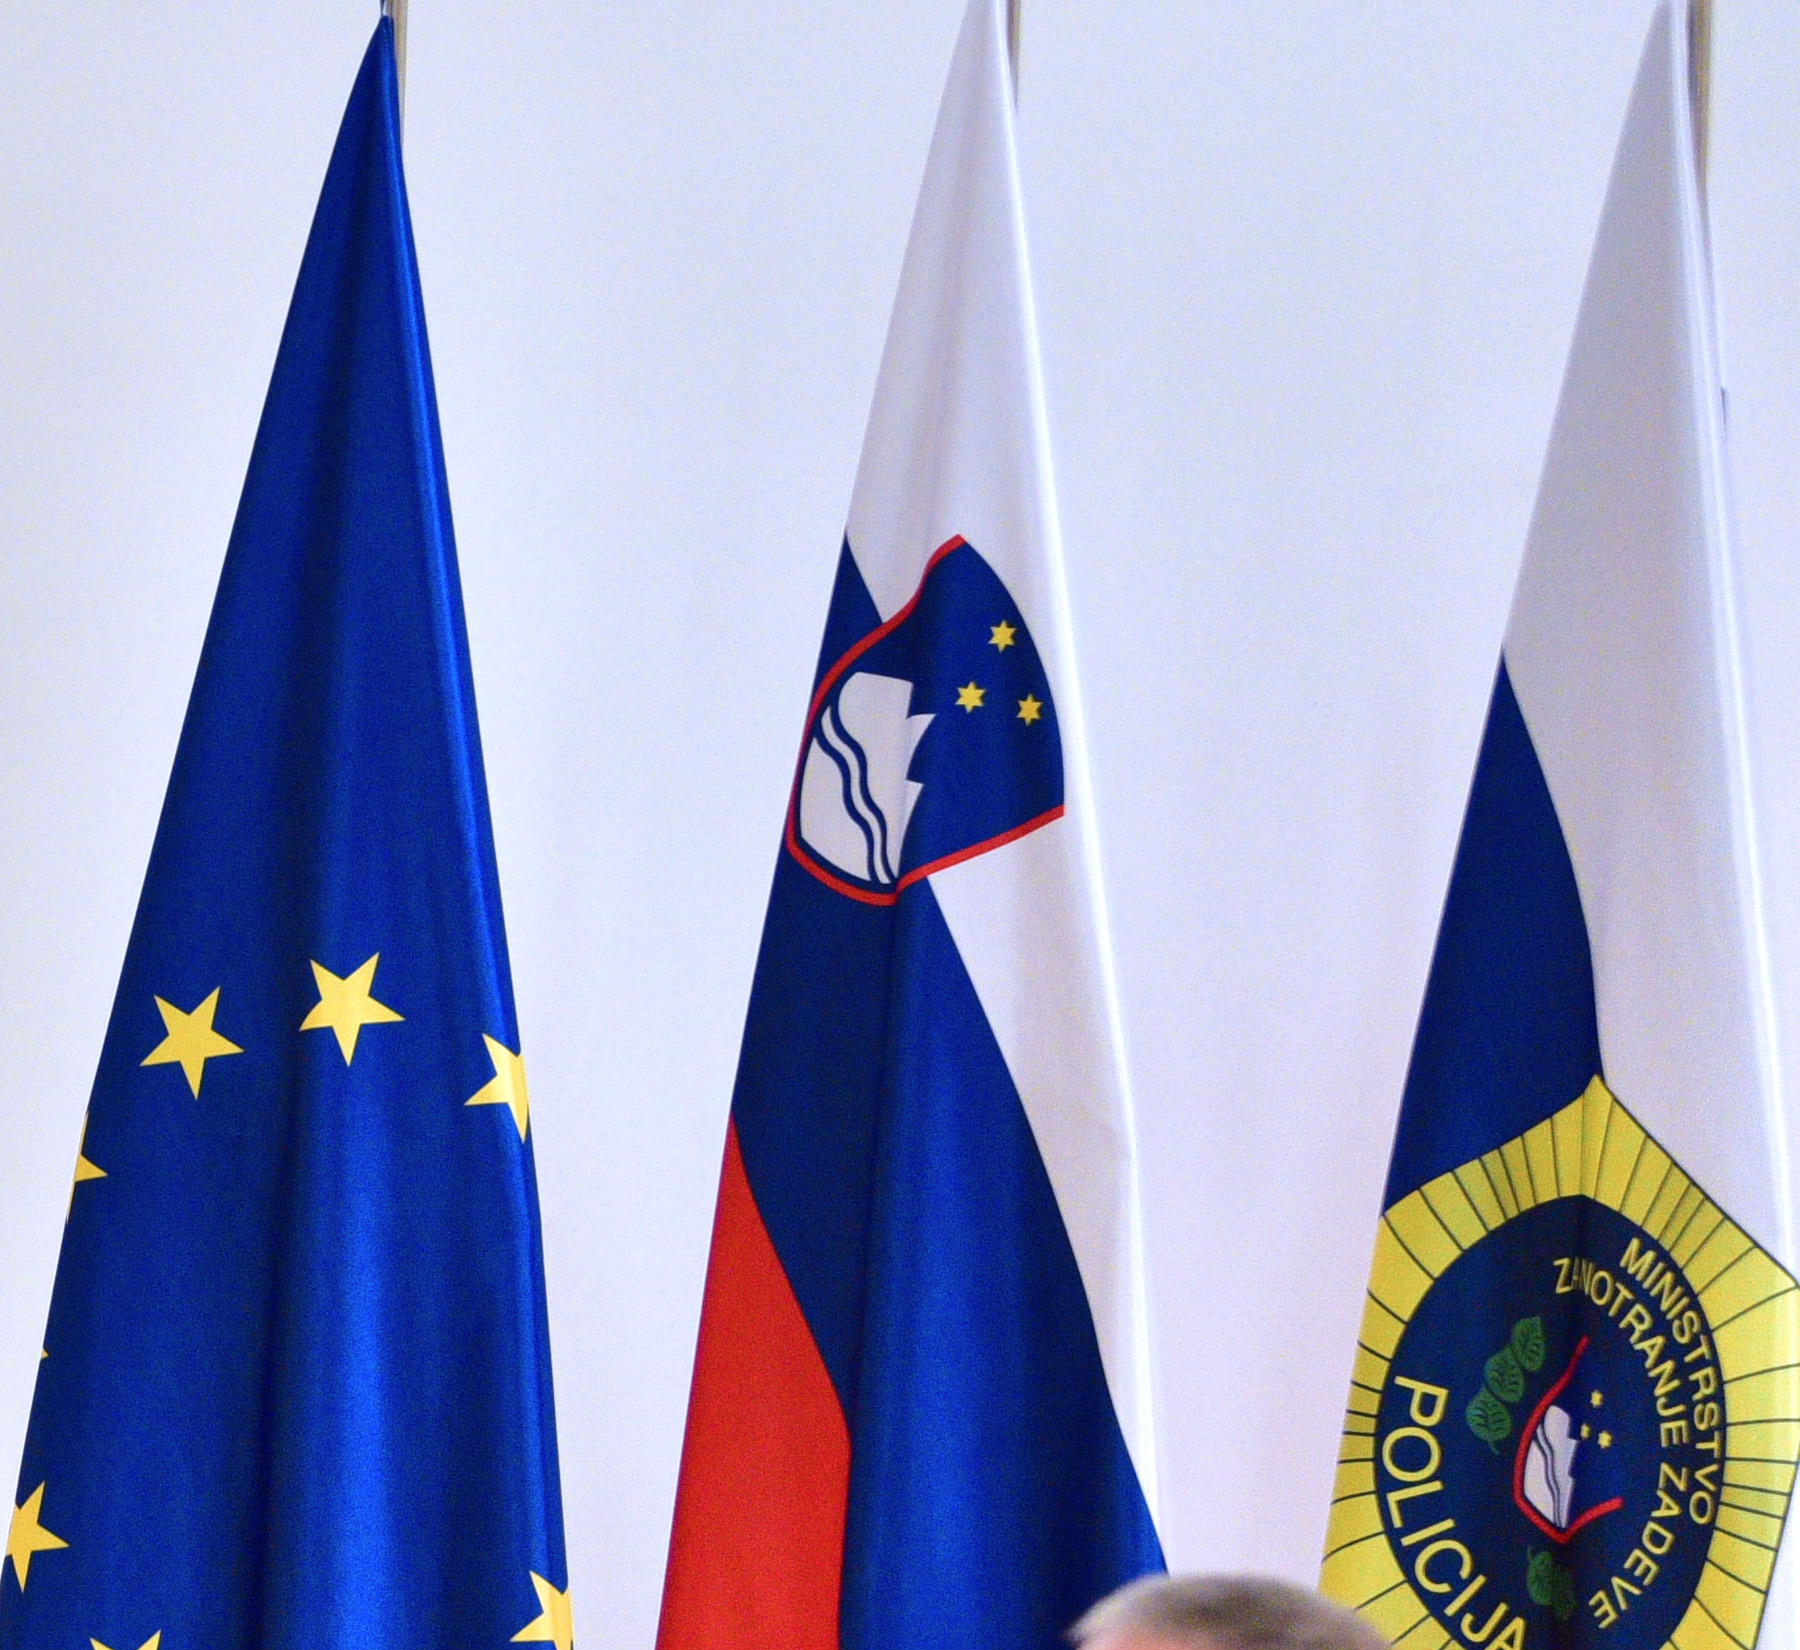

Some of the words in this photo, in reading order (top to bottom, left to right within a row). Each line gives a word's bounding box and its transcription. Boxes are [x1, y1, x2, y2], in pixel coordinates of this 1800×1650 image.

[1578, 1257, 1690, 1449] NOTRANJE
[1619, 1236, 1722, 1526] MINISTRSTVO
[1587, 1462, 1690, 1630] ZADEVE
